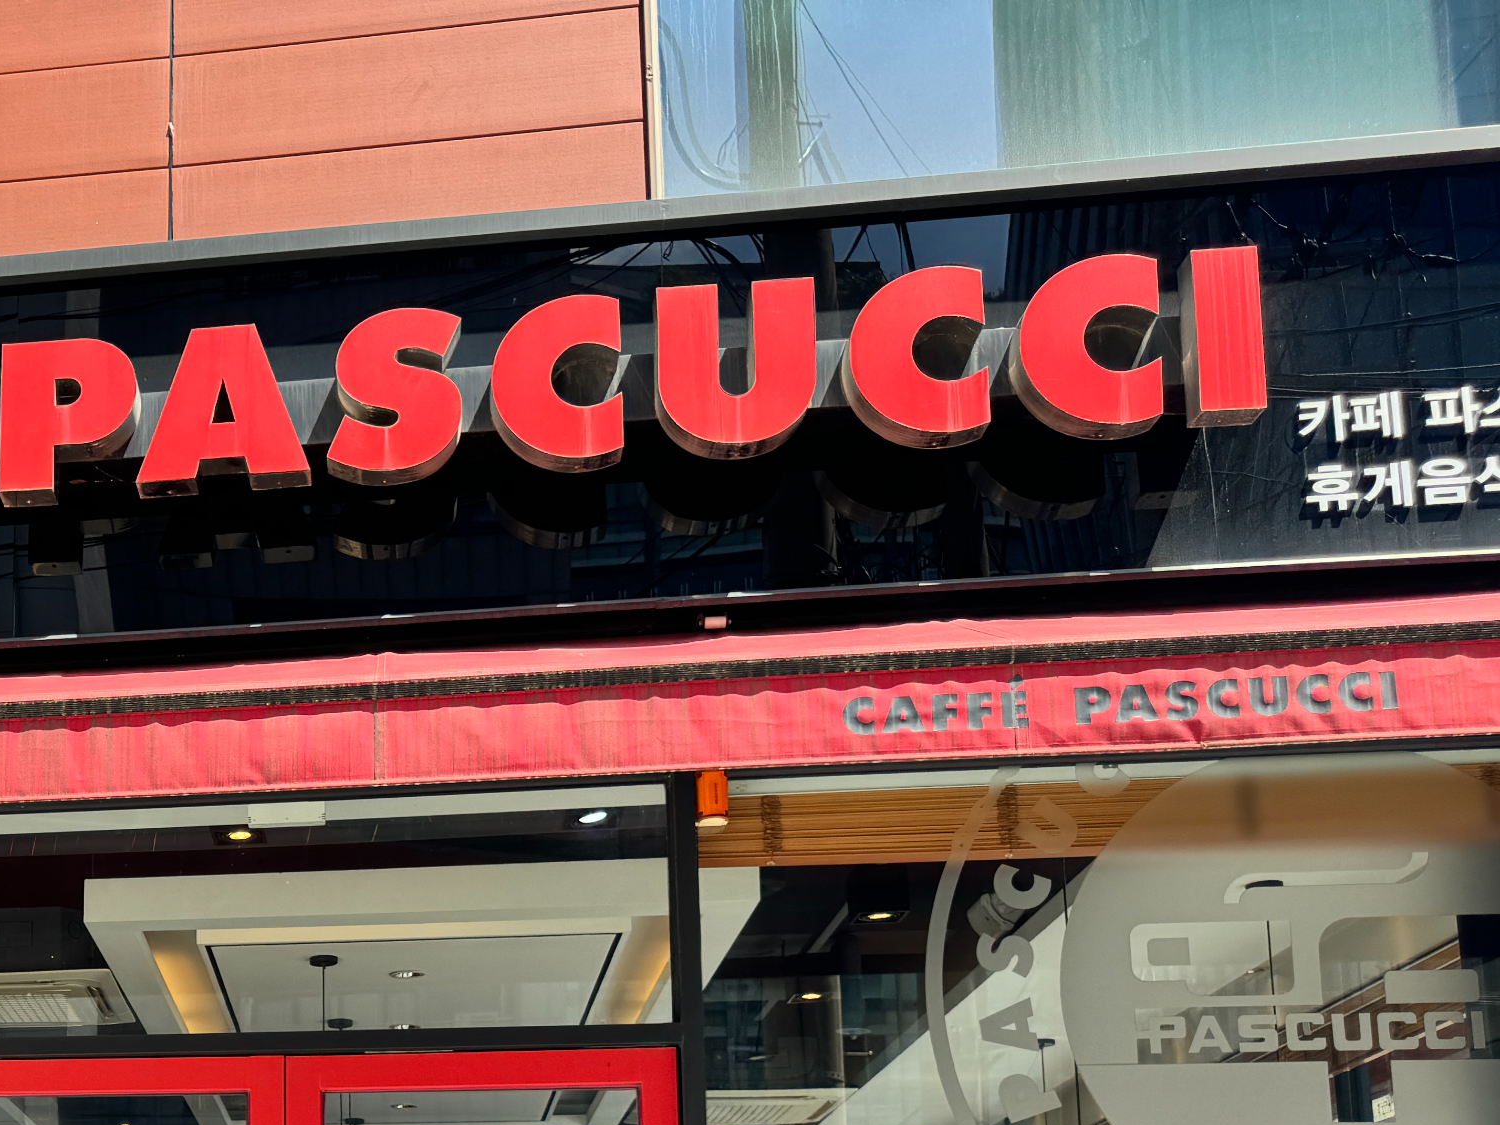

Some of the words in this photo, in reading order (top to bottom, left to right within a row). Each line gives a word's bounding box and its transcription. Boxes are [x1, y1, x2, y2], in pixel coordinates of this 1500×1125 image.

[1298, 390, 1403, 443] 카페
[842, 673, 1030, 736] CAFFÉ
[1073, 671, 1399, 725] PASCUCCI
[1137, 1011, 1486, 1055] PASCUCCI
